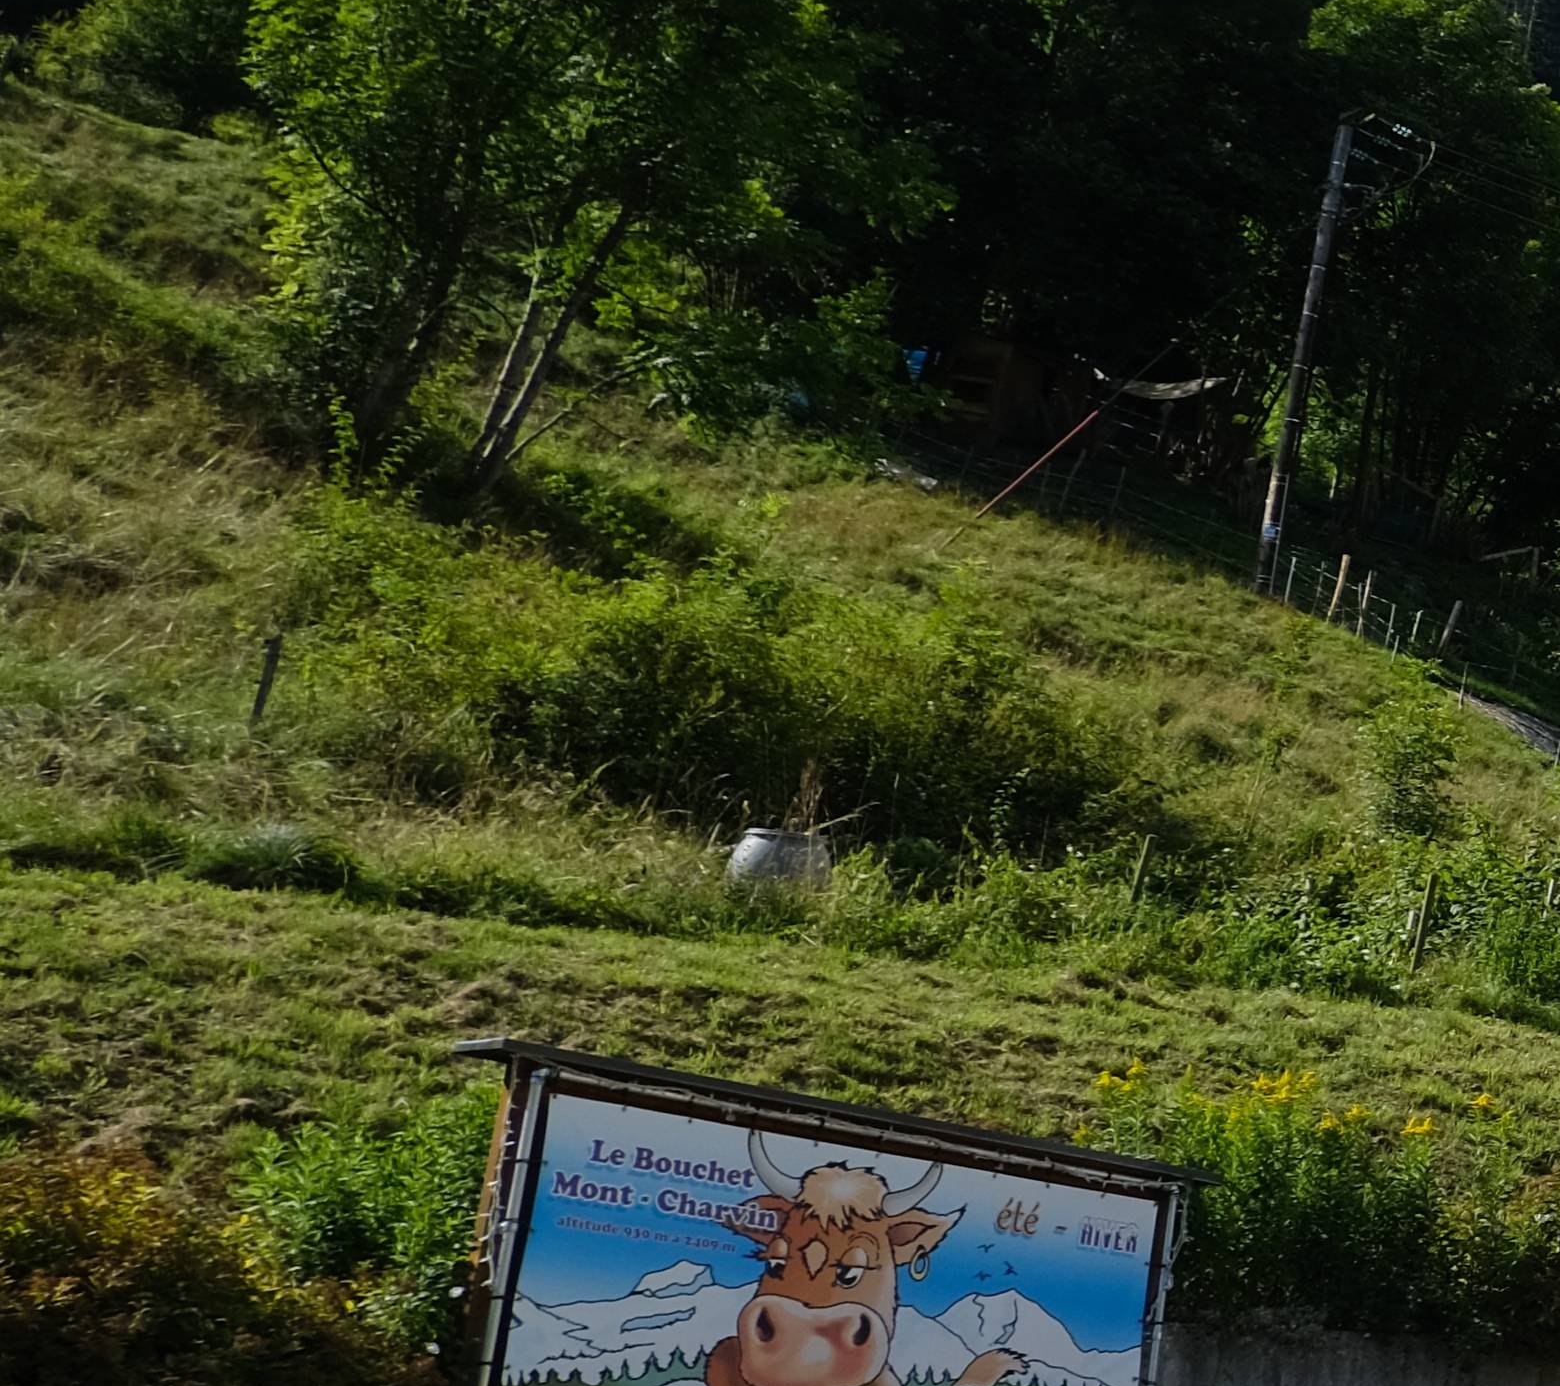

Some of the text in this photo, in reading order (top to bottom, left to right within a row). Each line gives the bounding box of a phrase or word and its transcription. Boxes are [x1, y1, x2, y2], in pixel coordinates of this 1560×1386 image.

[589, 1138, 756, 1189] Le Bouchet
[551, 1171, 635, 1206] Mont
[656, 1187, 778, 1230] Charvin
[995, 1196, 1041, 1236] été
[1079, 1215, 1140, 1254] HIVER
[555, 1215, 620, 1236] altitude
[623, 1225, 651, 1241] 930
